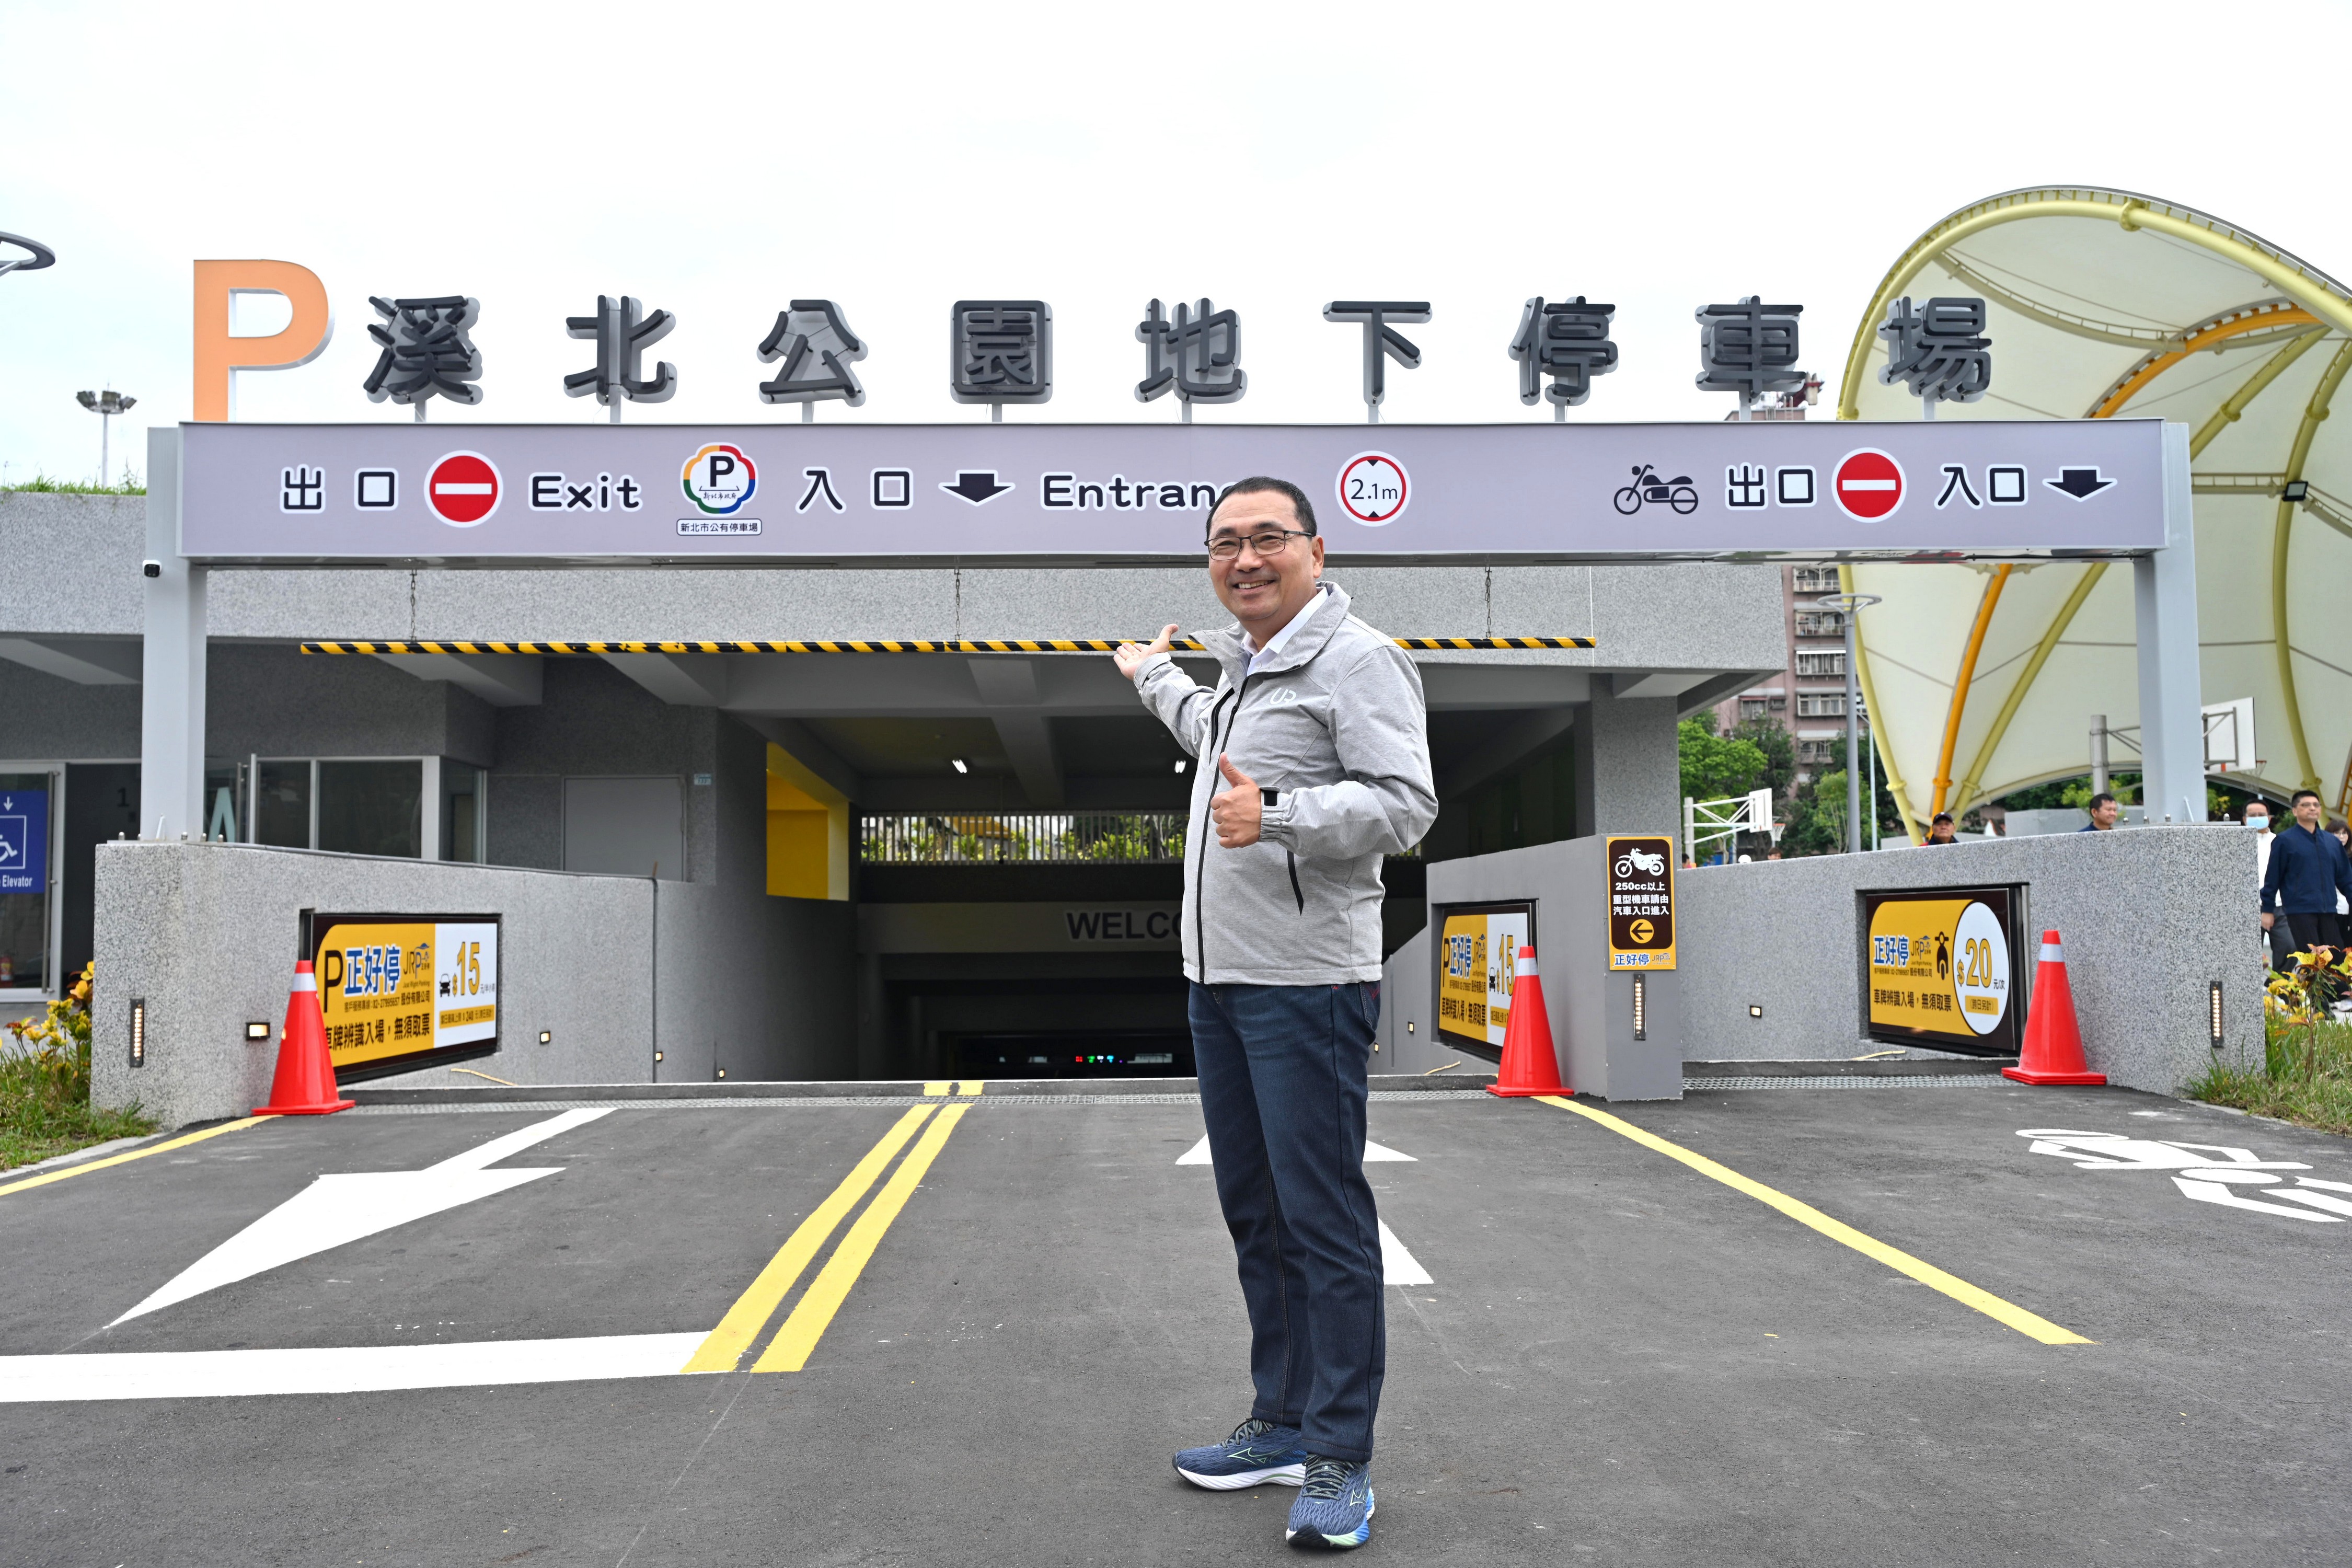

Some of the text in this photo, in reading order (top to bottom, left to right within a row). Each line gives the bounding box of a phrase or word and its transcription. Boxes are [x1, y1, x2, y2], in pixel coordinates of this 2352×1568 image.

[193, 259, 1992, 421] P 溪北公園地下停車場
[710, 456, 735, 487] P
[1729, 465, 2025, 507] 出口 入口
[284, 467, 641, 511] 出口 Exit
[799, 470, 1234, 510] 入口 Entran
[1351, 478, 1398, 500] 2.1m
[681, 523, 758, 533] 新北市公有停車場
[3, 874, 32, 887] Elevator
[1615, 882, 1666, 891] 250cc以上
[1613, 894, 1669, 905] 重型機車請由
[1613, 905, 1669, 916] 汽車入口進入
[1443, 938, 1450, 987] P
[1450, 934, 1472, 978] 正好停
[1615, 954, 1650, 965] 正好停
[1874, 936, 1909, 966] 正好停
[324, 950, 343, 1013] P
[344, 946, 400, 996] 正好停
